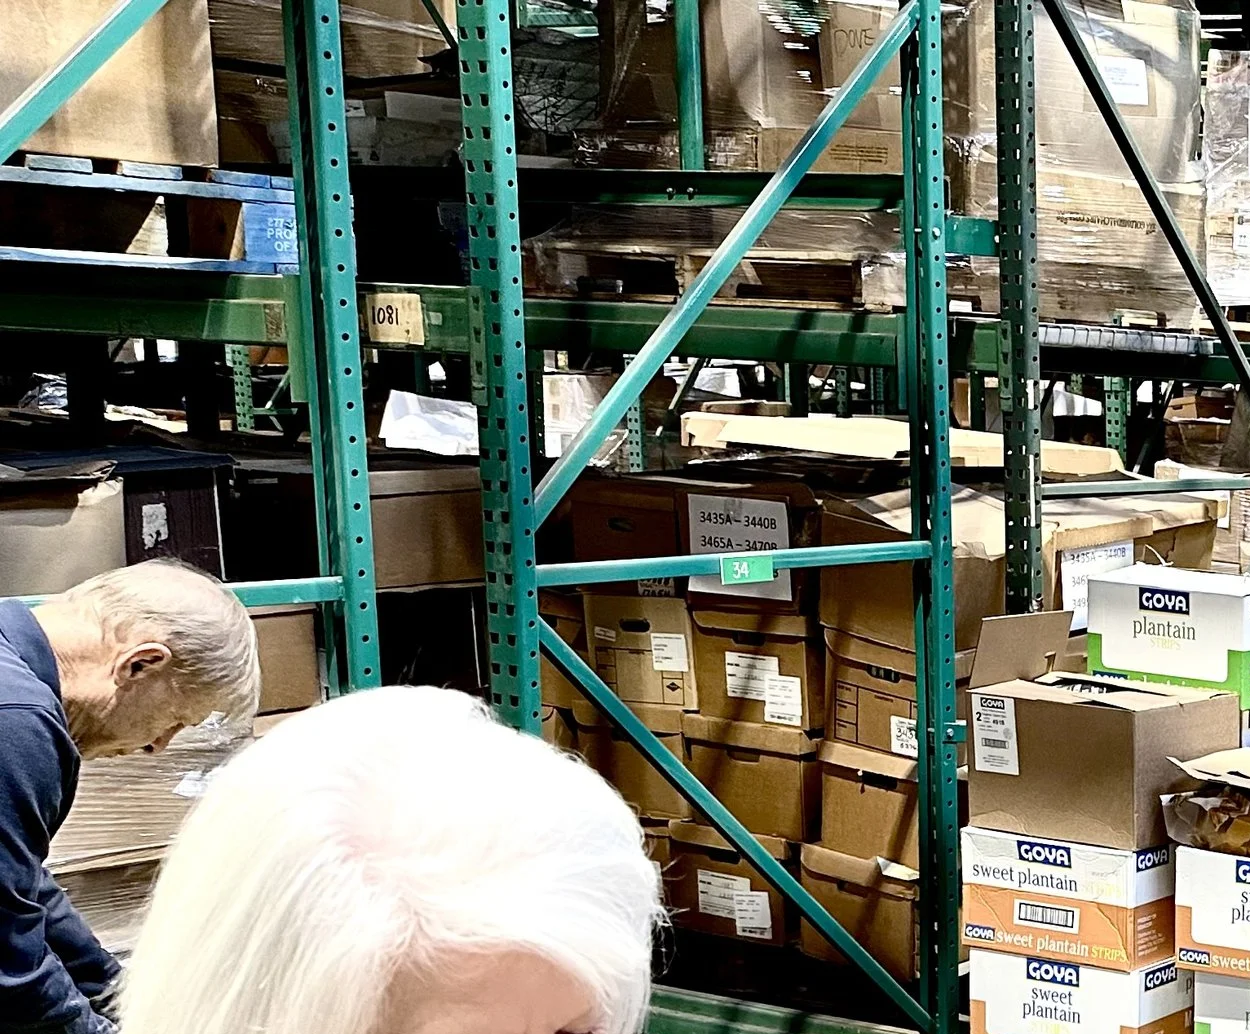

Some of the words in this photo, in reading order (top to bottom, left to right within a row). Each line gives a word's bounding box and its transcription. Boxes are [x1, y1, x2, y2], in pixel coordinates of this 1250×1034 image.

[267, 228, 292, 240] PRO
[372, 305, 399, 325] 1081
[700, 511, 733, 525] 3435A
[743, 515, 777, 530] 3440B
[700, 535, 734, 550] 3465A
[732, 561, 750, 579] 34
[1072, 598, 1088, 609] 349
[1142, 592, 1188, 612] GOYA
[1132, 616, 1196, 640] plantain
[981, 698, 1004, 709] GOYA
[1020, 843, 1070, 866] GOYA
[1137, 849, 1168, 870] GOYA
[972, 863, 1014, 882] sweet
[1018, 868, 1078, 892] plantain
[966, 925, 994, 940] GOYA
[996, 930, 1033, 947] sweet
[1036, 936, 1089, 956] plantain
[1091, 946, 1126, 962] STRIPS
[1179, 950, 1210, 964] GOYA
[1028, 960, 1078, 985] GOYA
[1145, 966, 1177, 989] GOYA
[1031, 987, 1073, 1006] sweet
[1022, 1002, 1081, 1024] plantain
